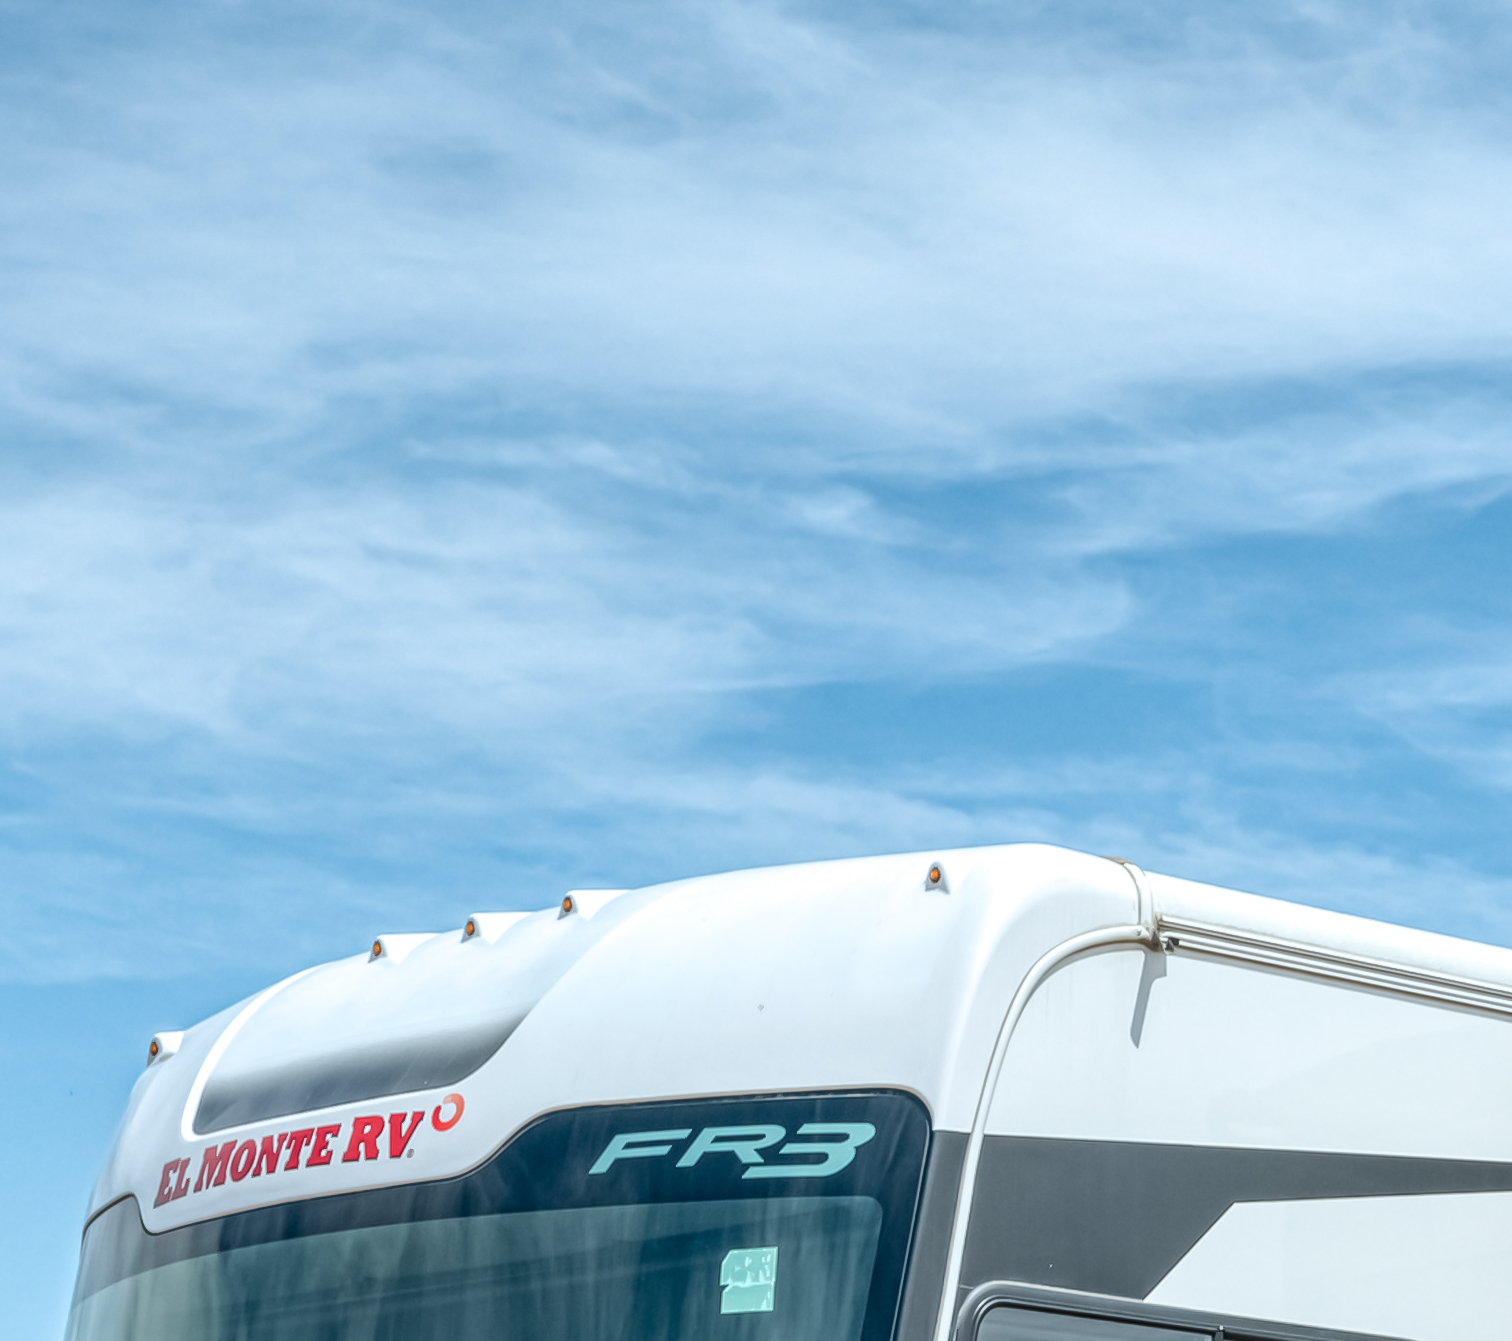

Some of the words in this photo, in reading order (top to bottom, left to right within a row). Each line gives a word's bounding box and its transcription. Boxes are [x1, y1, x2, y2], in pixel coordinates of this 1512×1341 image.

[153, 1157, 190, 1209] EL
[193, 1123, 341, 1193] MONTE
[341, 1111, 425, 1163] RV
[588, 1122, 876, 1179] FR3
